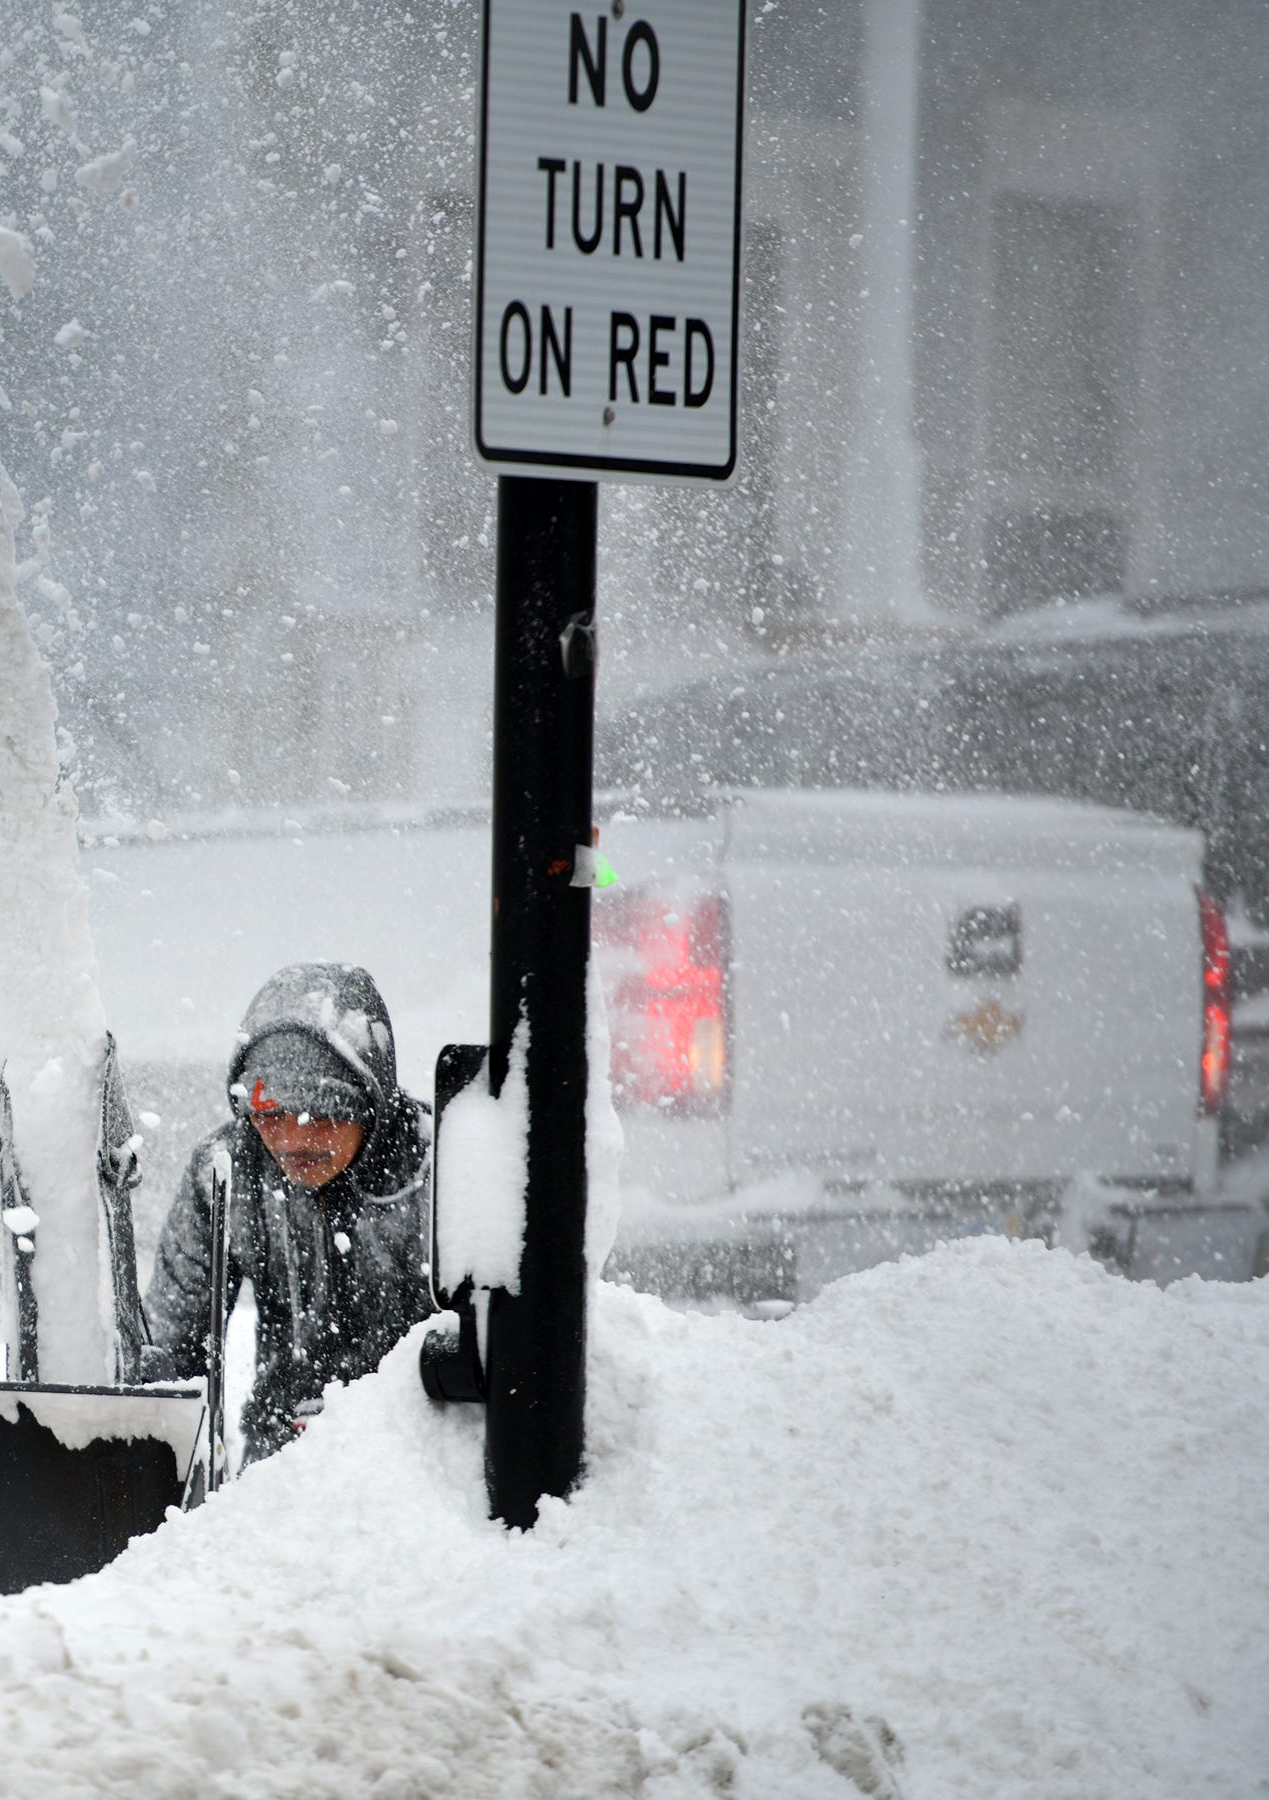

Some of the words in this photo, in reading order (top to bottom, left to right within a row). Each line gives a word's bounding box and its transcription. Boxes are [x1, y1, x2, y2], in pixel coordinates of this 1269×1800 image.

[568, 12, 660, 112] NO
[537, 156, 687, 262] TURN
[499, 300, 573, 398] ON
[609, 311, 715, 408] RED
